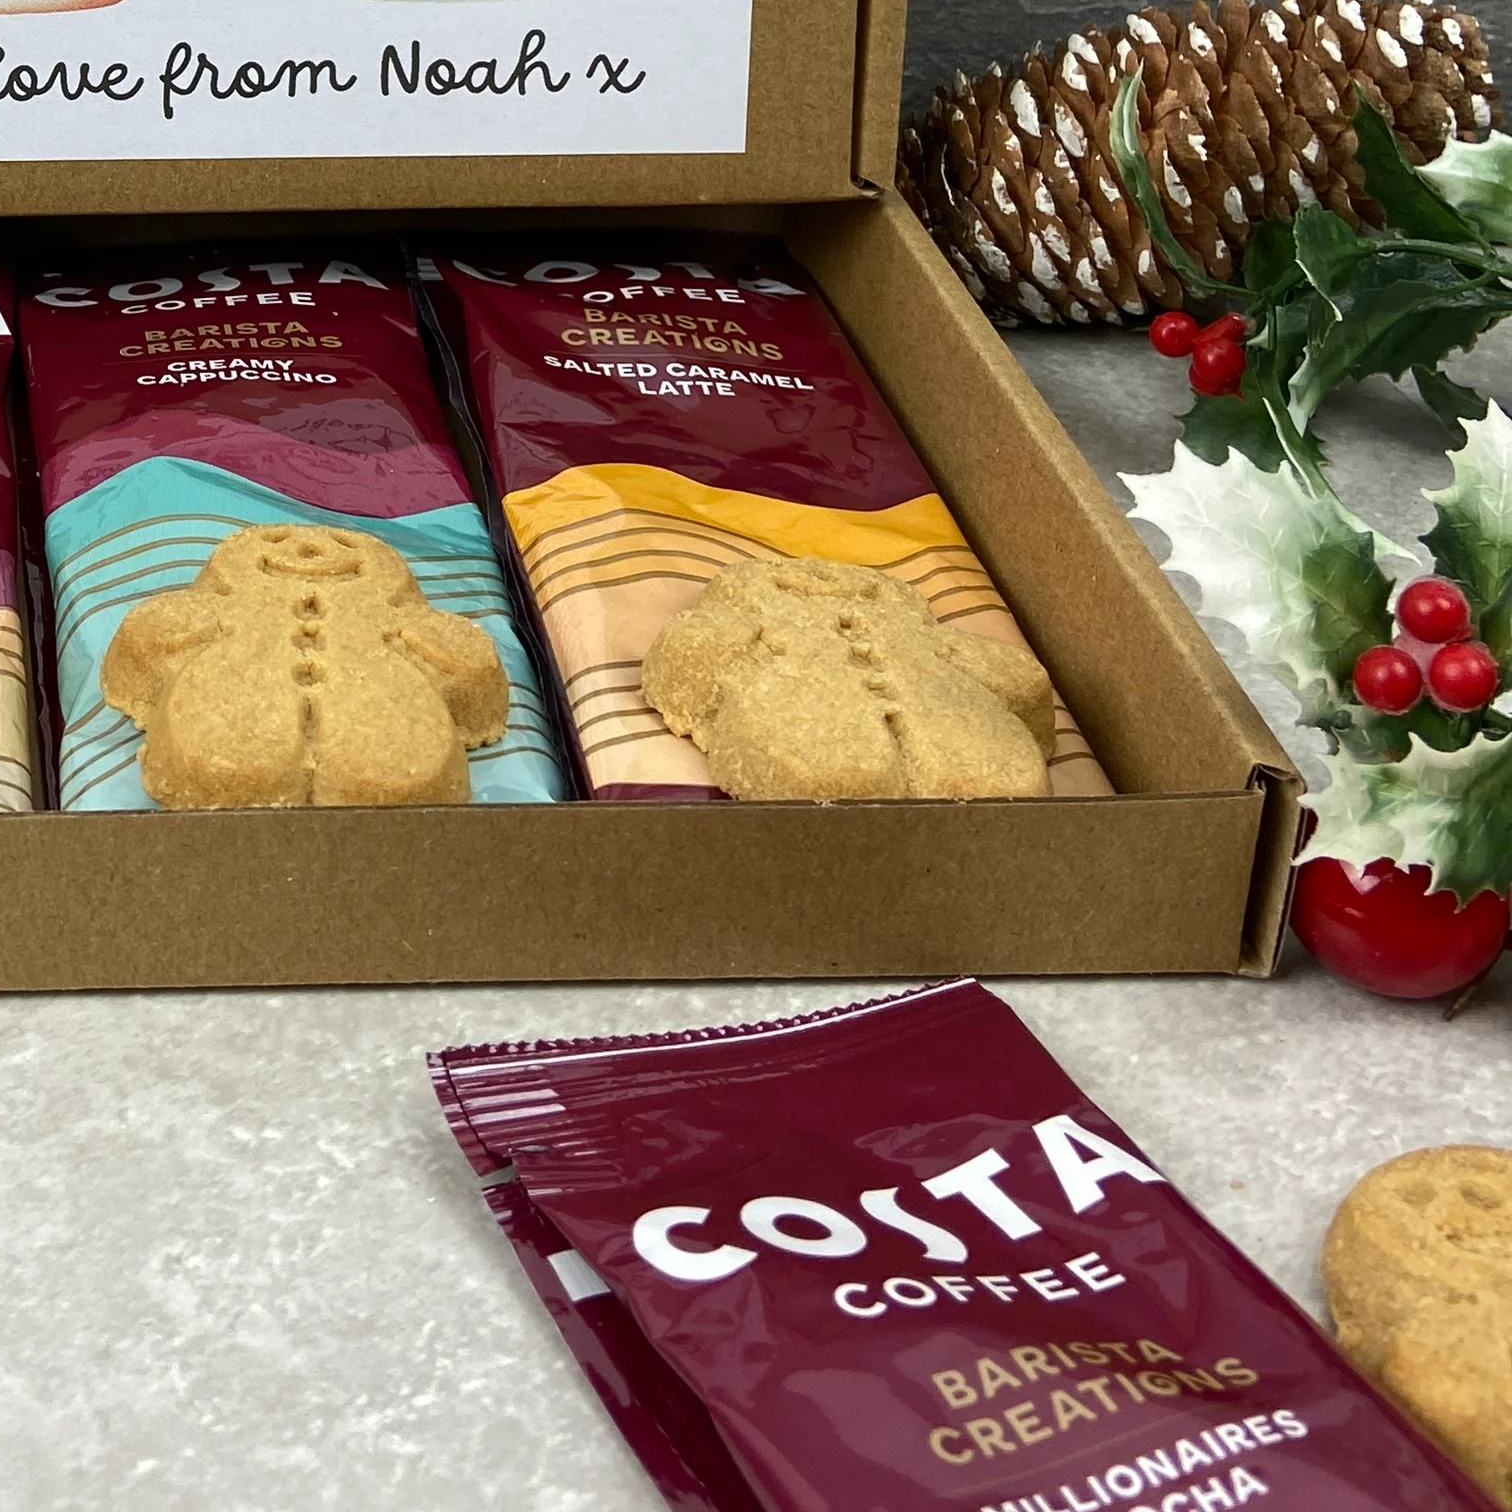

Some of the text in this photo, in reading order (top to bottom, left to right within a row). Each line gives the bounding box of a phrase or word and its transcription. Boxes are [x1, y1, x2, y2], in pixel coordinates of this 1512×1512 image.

[158, 41, 358, 120] from
[380, 29, 571, 97] Noah
[585, 54, 648, 94] x
[34, 260, 390, 308] COSTA
[558, 285, 746, 304] OFFEE
[121, 291, 316, 315] COFFEE
[144, 320, 309, 342] BARISTA
[583, 307, 748, 337] BARISTA
[119, 335, 343, 358] CREATIONS
[560, 328, 785, 361] CREATIONS
[137, 369, 337, 387] CAPPUCCINO
[167, 358, 294, 373] CREAMY
[543, 355, 815, 391] SALTED CARAMEL
[638, 380, 736, 397] LATTE
[632, 1114, 1168, 1282] COSTA
[834, 1251, 1126, 1318] COFFEE
[931, 1338, 1183, 1410] BARISTA
[928, 1356, 1259, 1465] CREATIONS
[979, 1408, 1309, 1512] ILLIONAIRES
